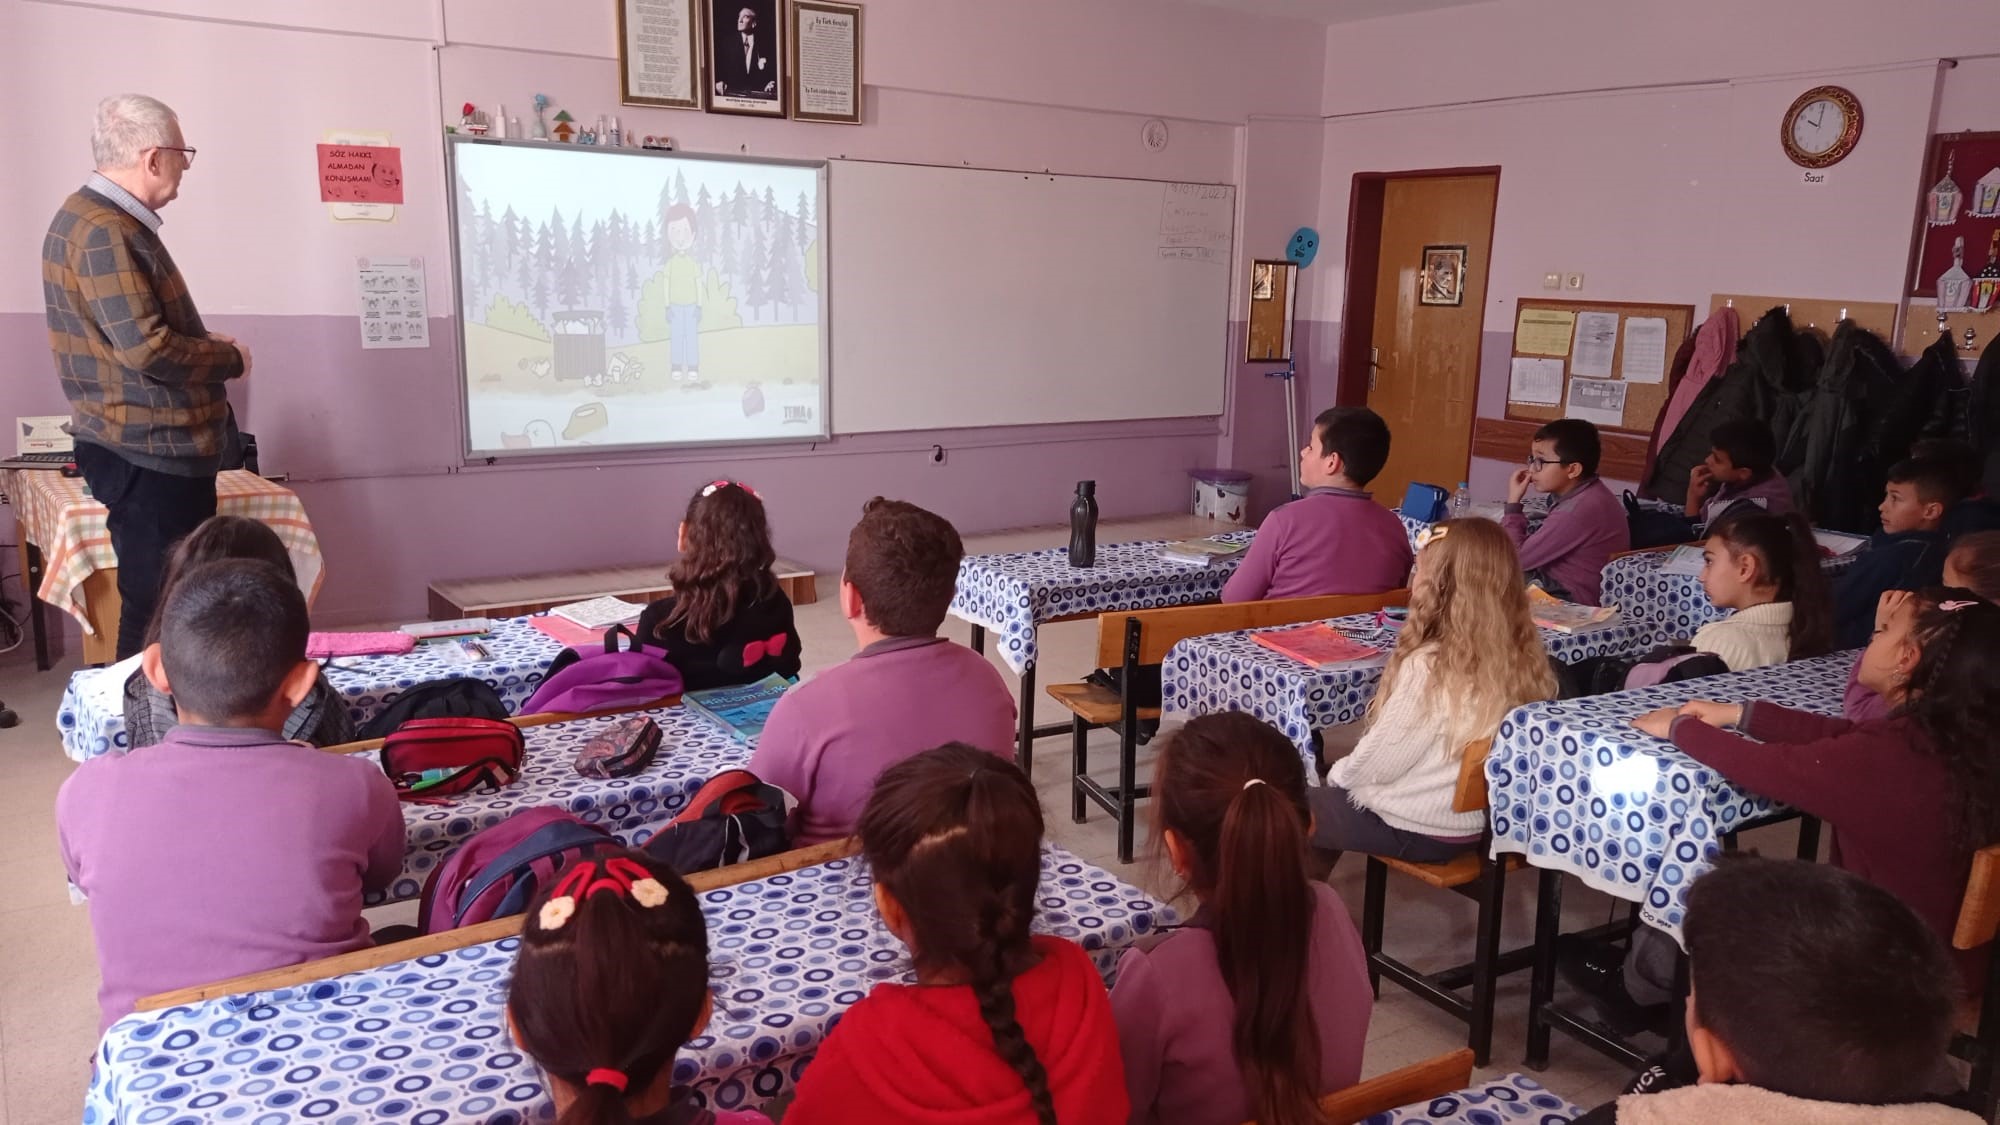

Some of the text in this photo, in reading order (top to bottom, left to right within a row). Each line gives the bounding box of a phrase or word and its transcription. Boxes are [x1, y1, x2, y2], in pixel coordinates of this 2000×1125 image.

[329, 149, 372, 159] SÖZ HAKKI
[327, 162, 365, 170] ALMADAN
[1804, 172, 1824, 183] Saat
[783, 405, 806, 419] TEMA
